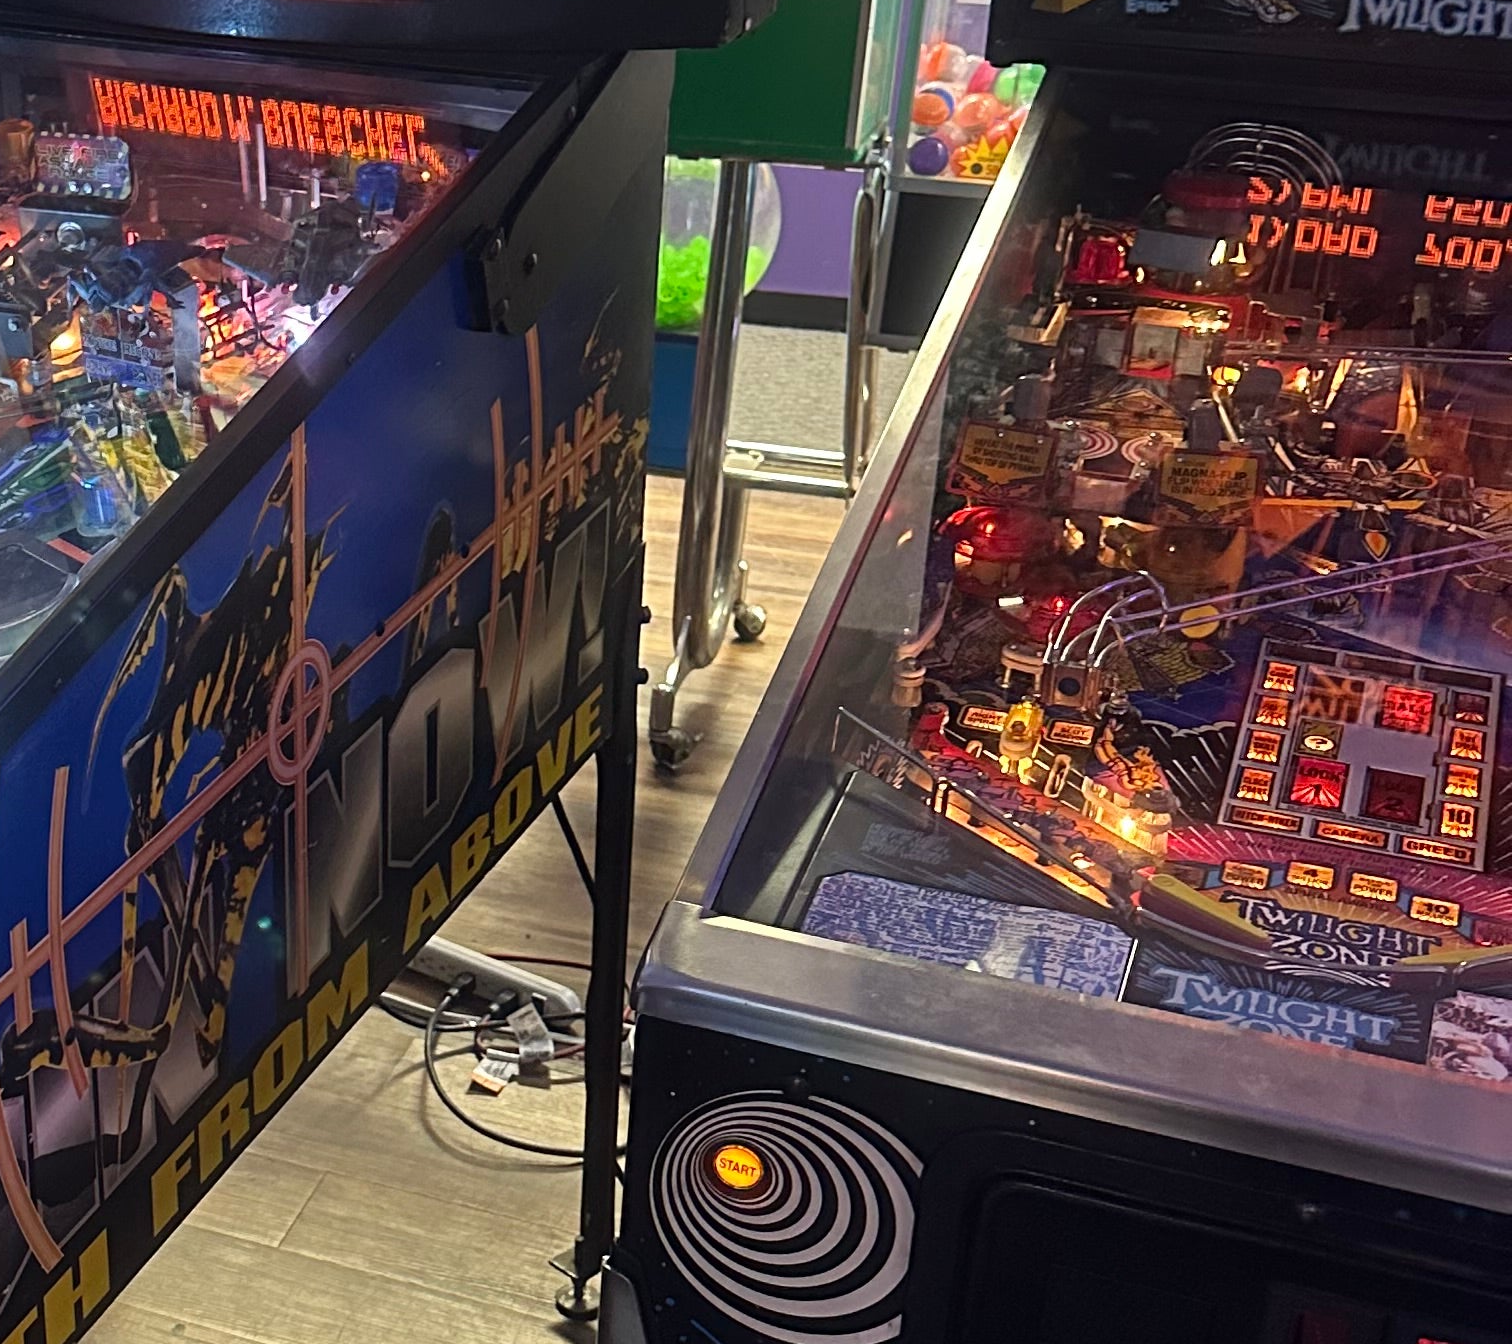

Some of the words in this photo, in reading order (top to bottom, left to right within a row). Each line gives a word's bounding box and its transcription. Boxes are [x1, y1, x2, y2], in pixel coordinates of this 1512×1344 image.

[283, 498, 611, 981] NOW!
[1446, 807, 1472, 825] 10
[1405, 839, 1469, 859] GREED
[1223, 892, 1439, 956] TWILIGHT
[150, 940, 372, 1238] FROM
[402, 684, 604, 957] ABOVE
[1155, 967, 1399, 1045] TWILIGHT
[716, 1155, 760, 1179] START
